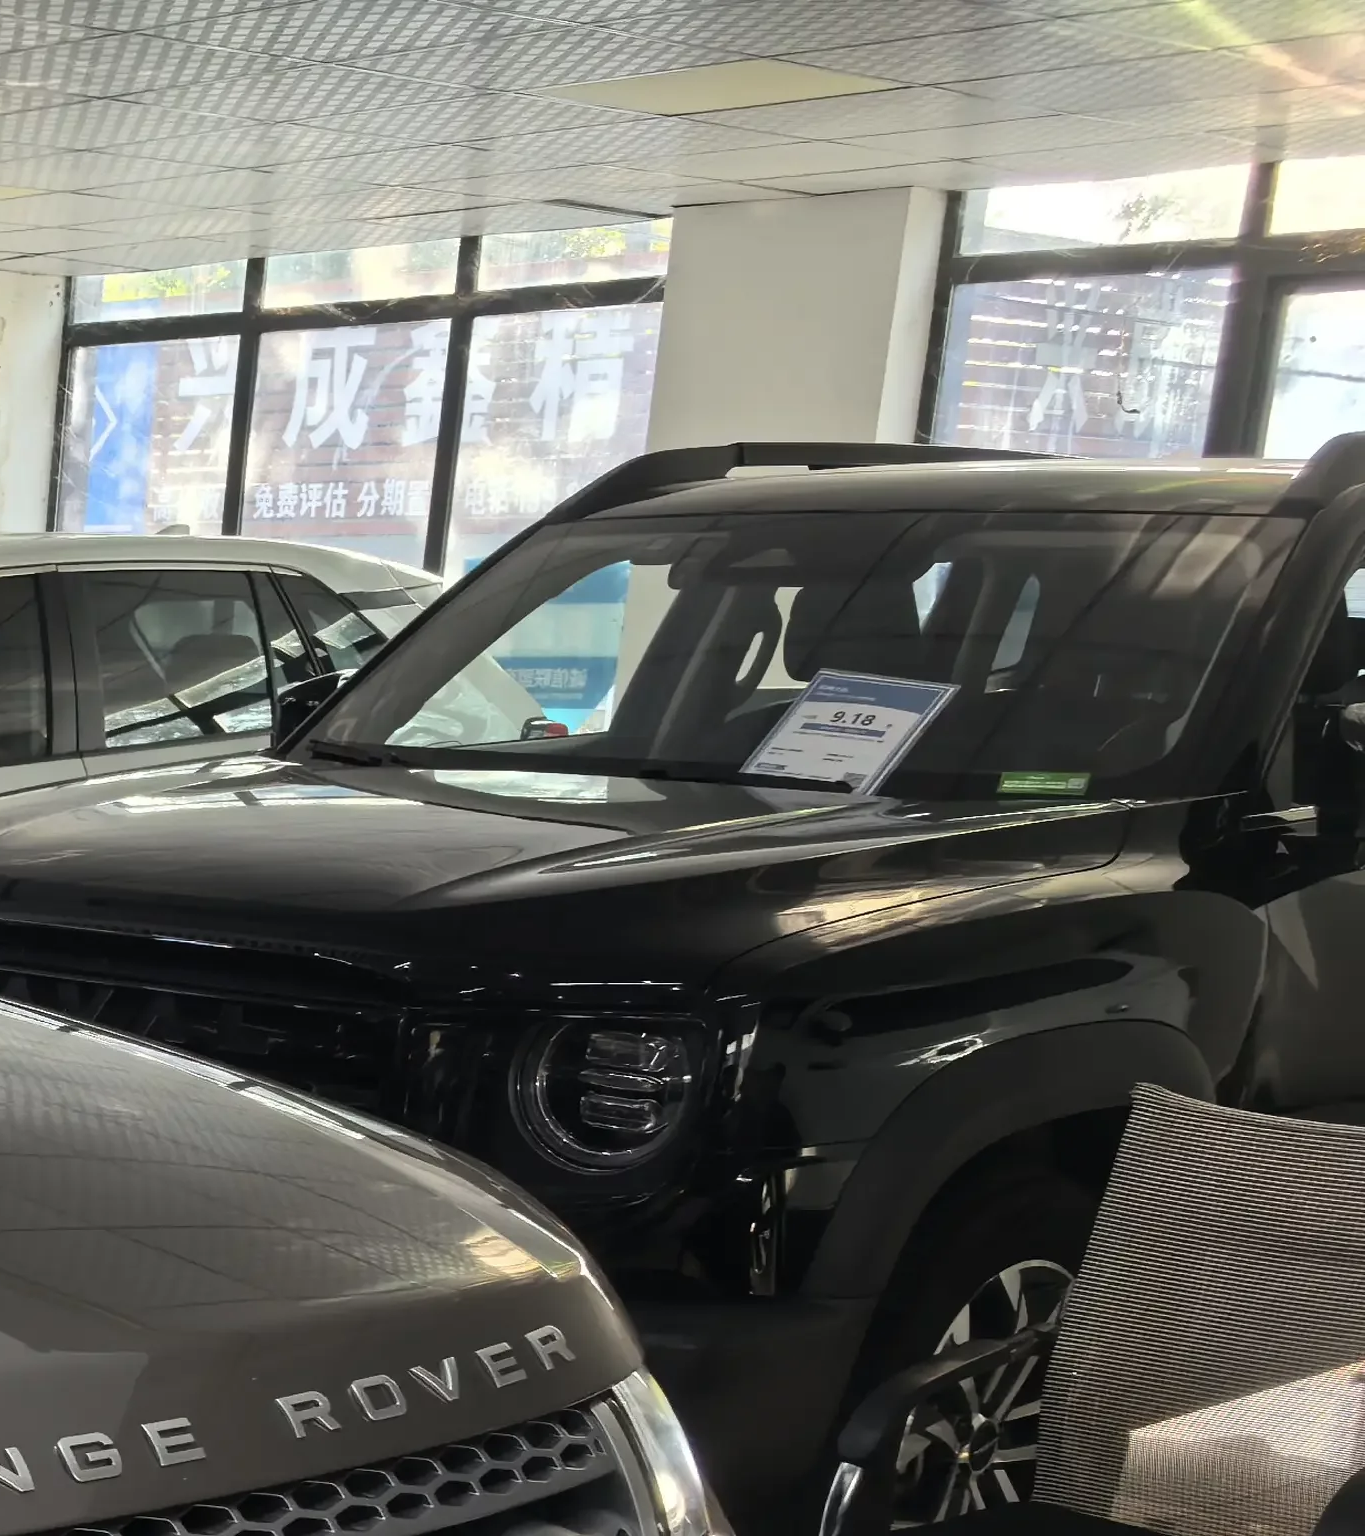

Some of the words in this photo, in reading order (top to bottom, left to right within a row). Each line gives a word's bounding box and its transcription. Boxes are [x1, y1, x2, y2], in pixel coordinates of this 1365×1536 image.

[253, 482, 348, 519] 免费评估
[356, 478, 431, 518] 分期置
[830, 710, 876, 727] 9.18
[275, 1324, 577, 1440] ROVER
